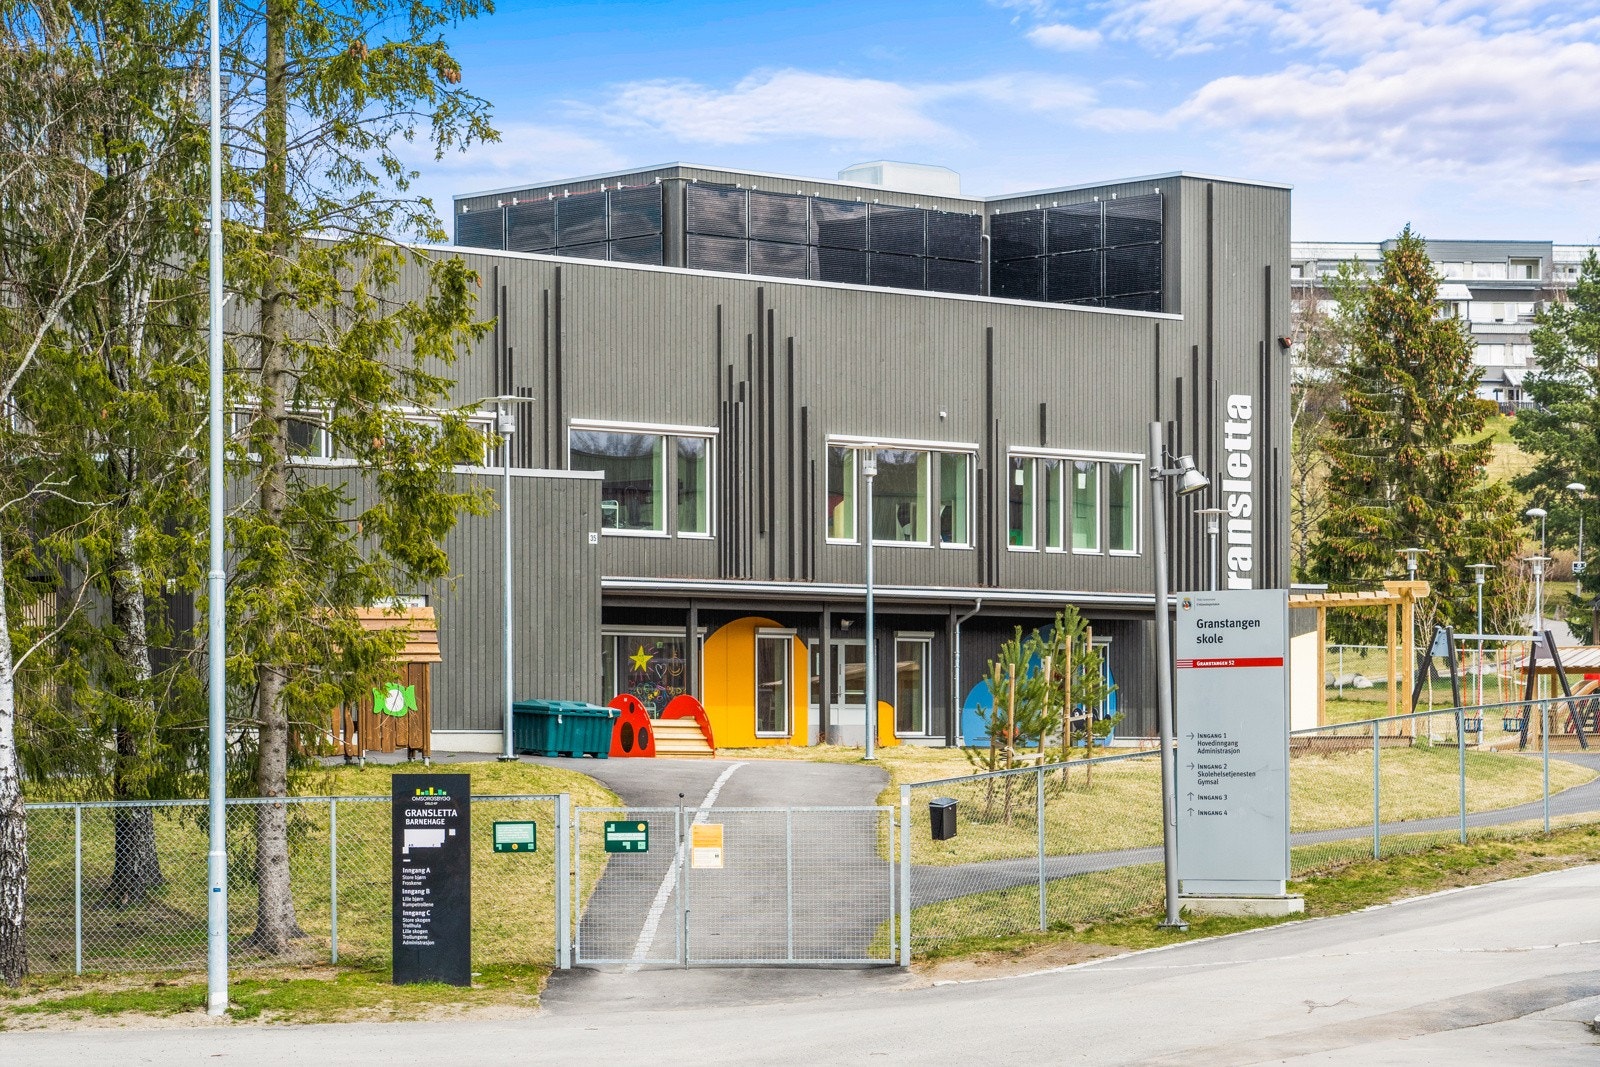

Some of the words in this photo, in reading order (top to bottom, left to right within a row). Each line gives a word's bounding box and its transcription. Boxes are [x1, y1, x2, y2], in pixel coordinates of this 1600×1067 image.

[1223, 394, 1252, 590] ransletta
[1196, 618, 1260, 630] Granstangen
[1196, 634, 1224, 644] skole
